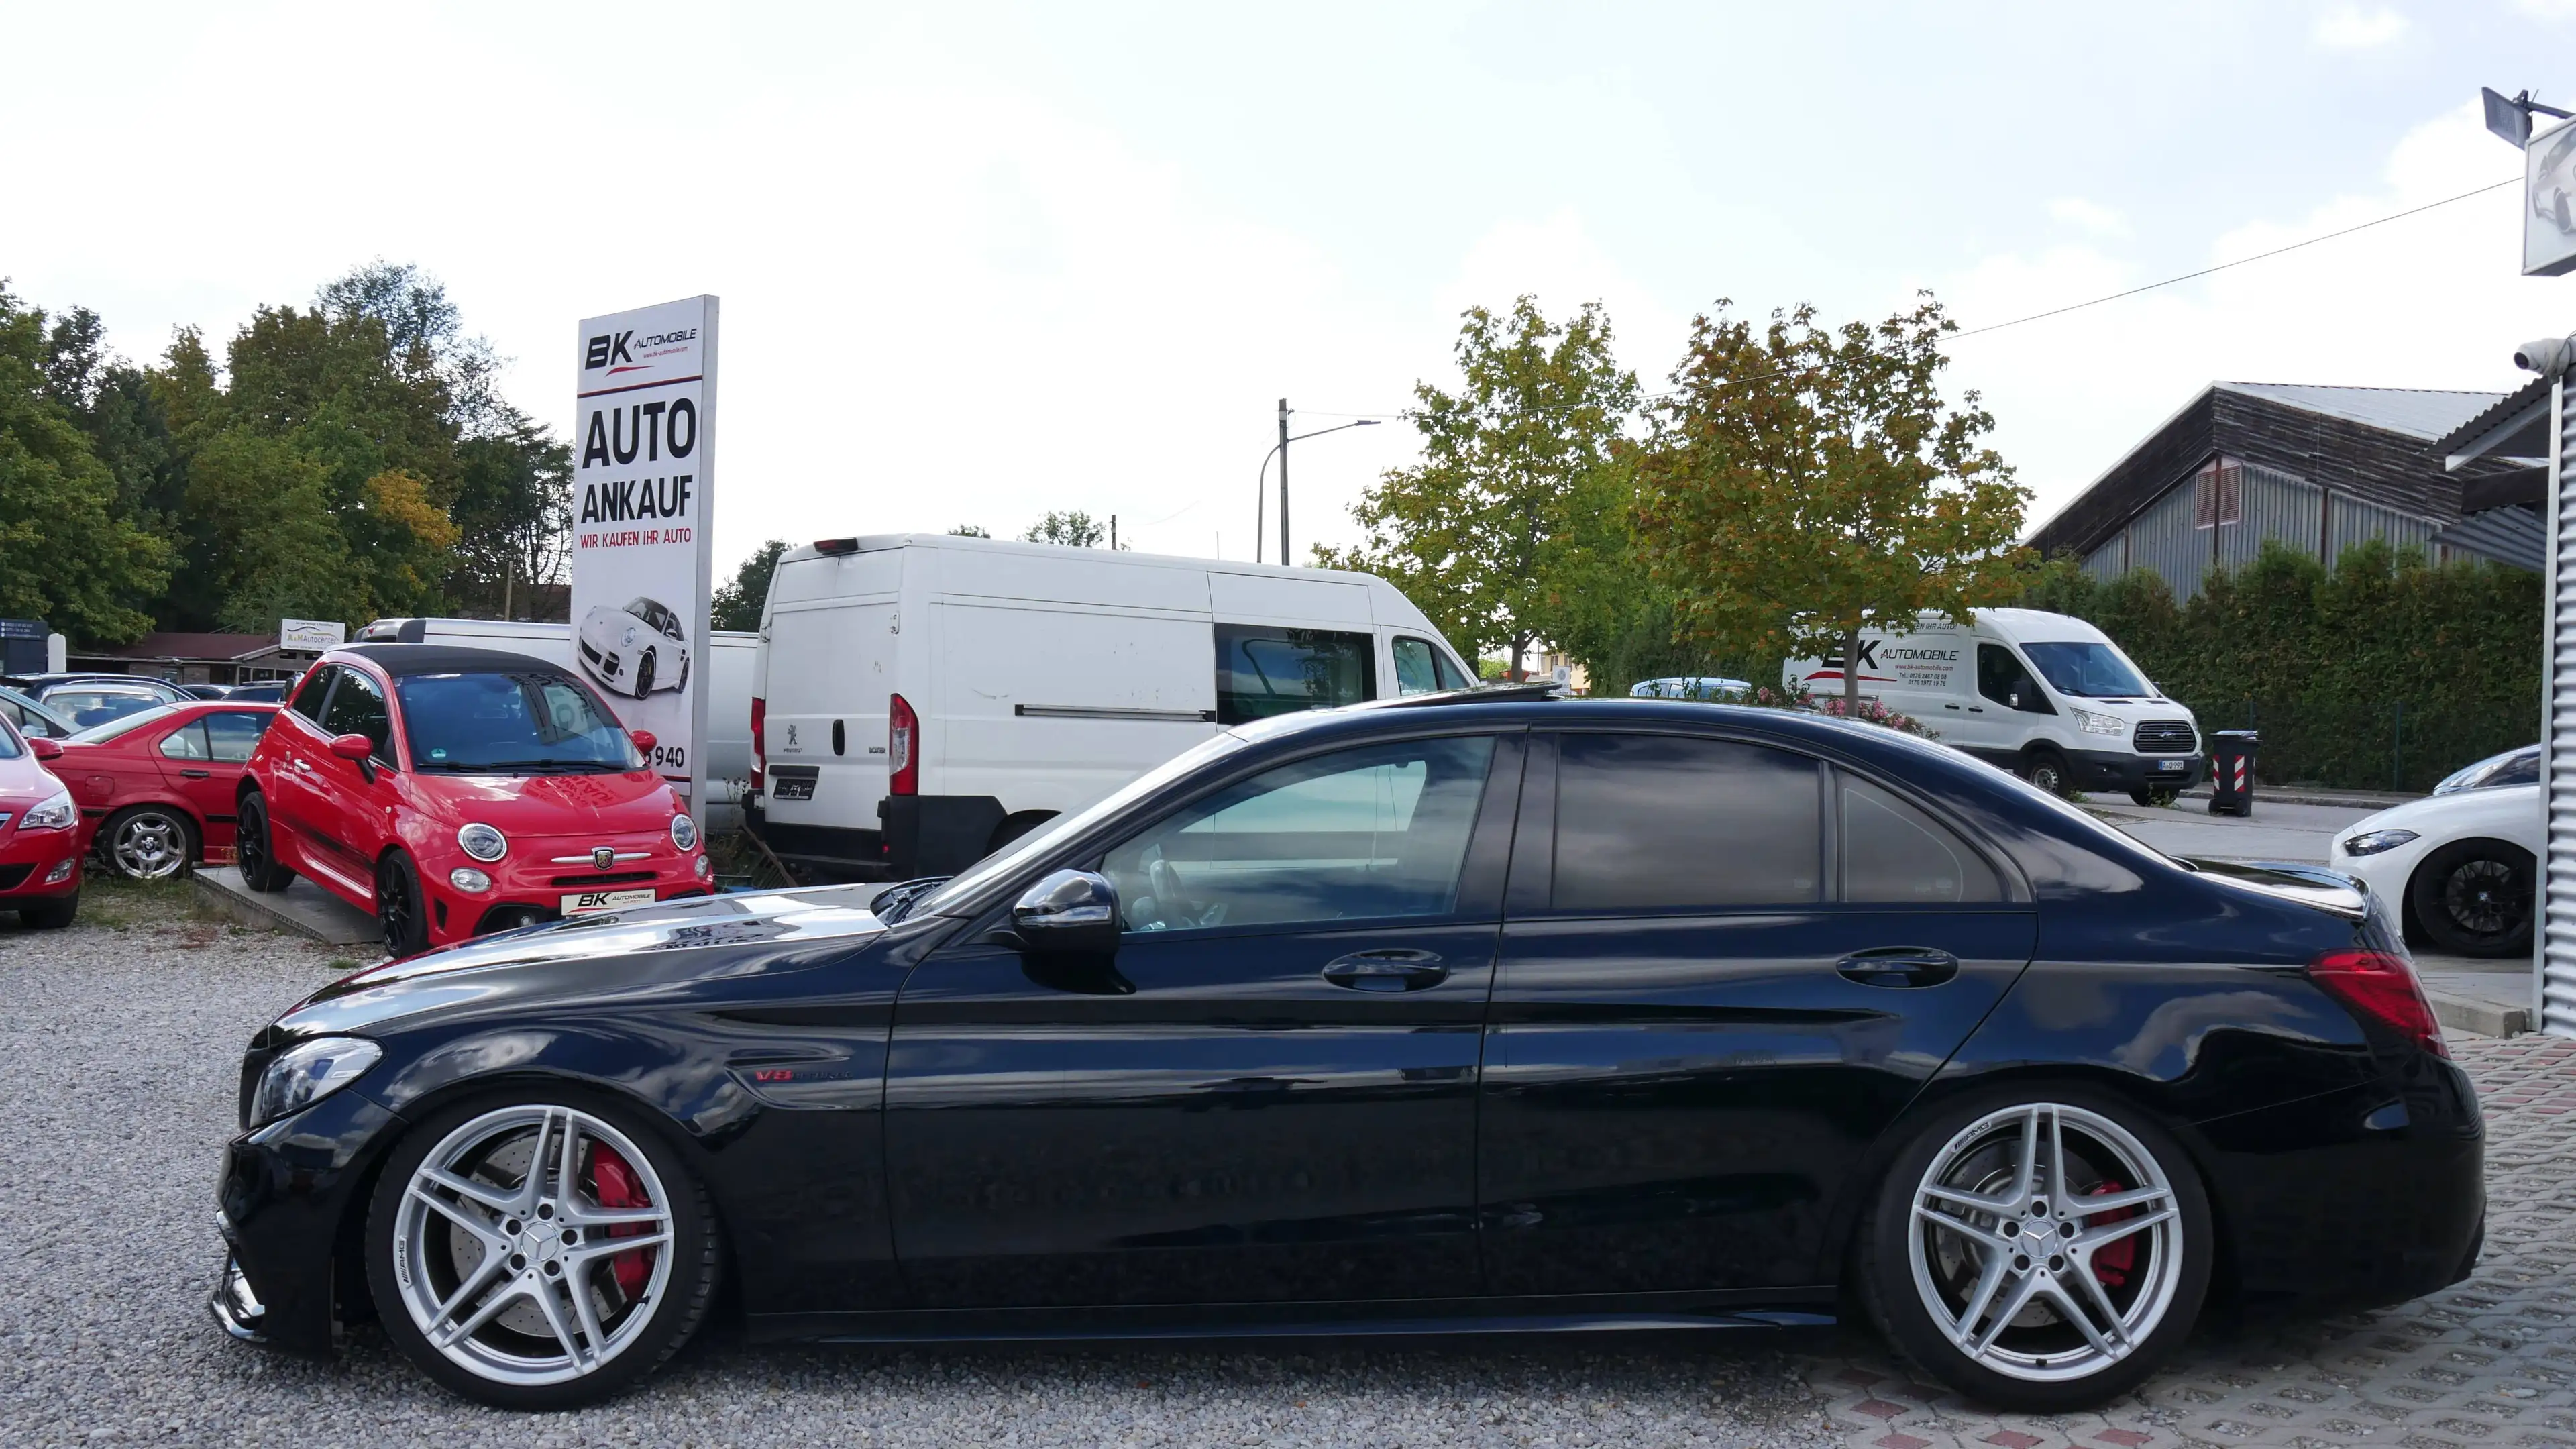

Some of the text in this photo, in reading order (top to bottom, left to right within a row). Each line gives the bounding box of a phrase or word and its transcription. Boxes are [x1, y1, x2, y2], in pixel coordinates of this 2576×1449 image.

[585, 329, 696, 370] BK AUTOMOBILE
[582, 398, 696, 469] AUTO
[581, 474, 693, 524] ANKAUF
[580, 528, 692, 548] WIR KAUFEN IHR AUTO
[303, 635, 336, 644] Autocenter
[1880, 649, 1960, 661] AUTOMOBILE
[578, 893, 611, 906] BK
[755, 1070, 792, 1081] V8
